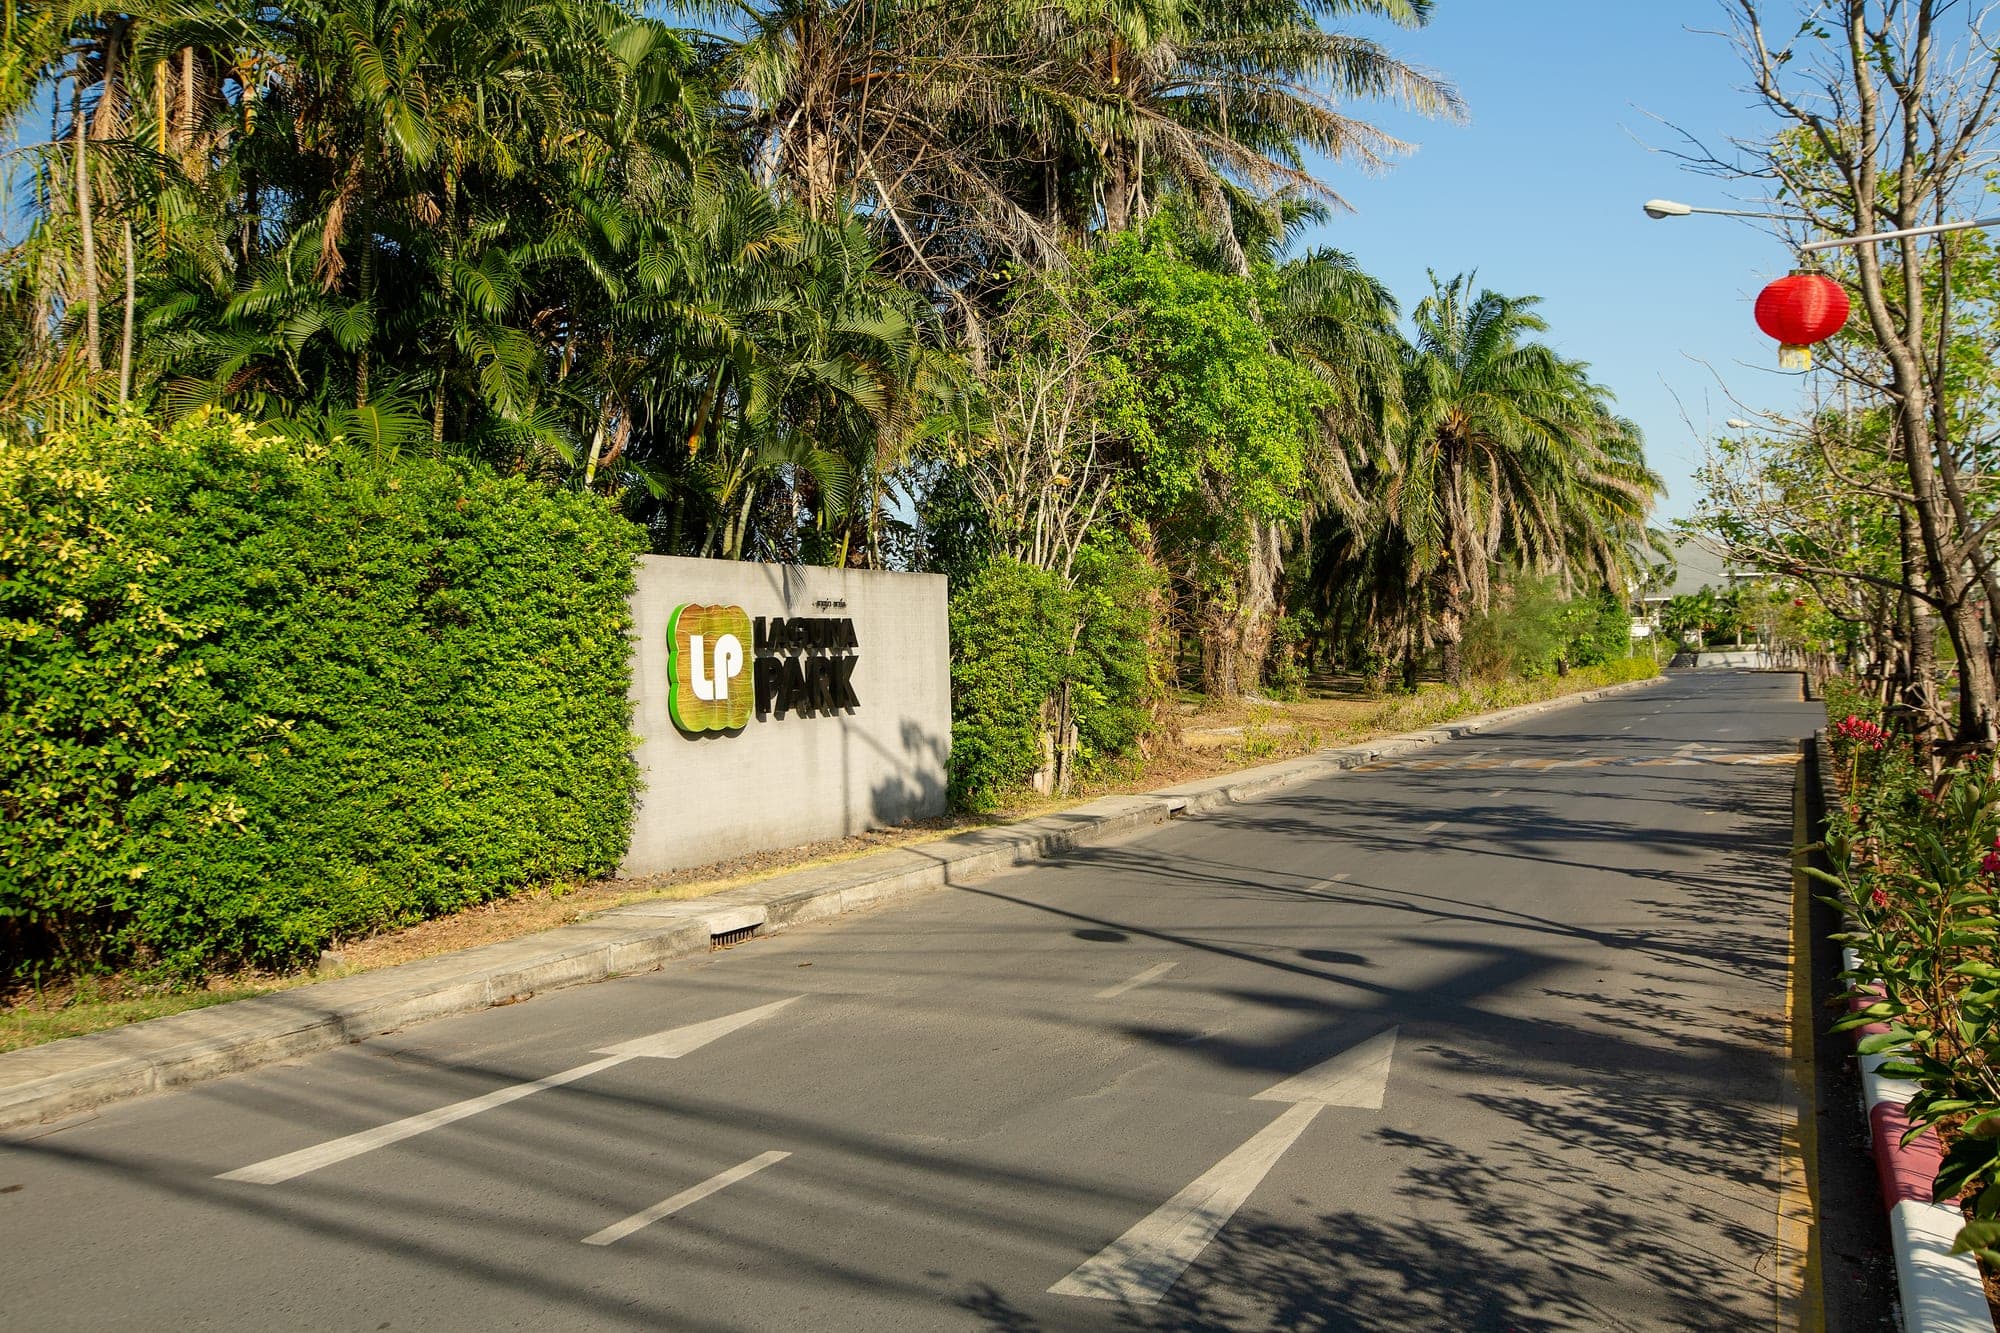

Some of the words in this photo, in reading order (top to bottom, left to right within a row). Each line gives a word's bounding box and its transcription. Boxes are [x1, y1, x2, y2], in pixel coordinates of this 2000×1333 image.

[753, 616, 859, 653] LAGUNA
[690, 634, 743, 700] LP
[754, 656, 861, 717] PARK
